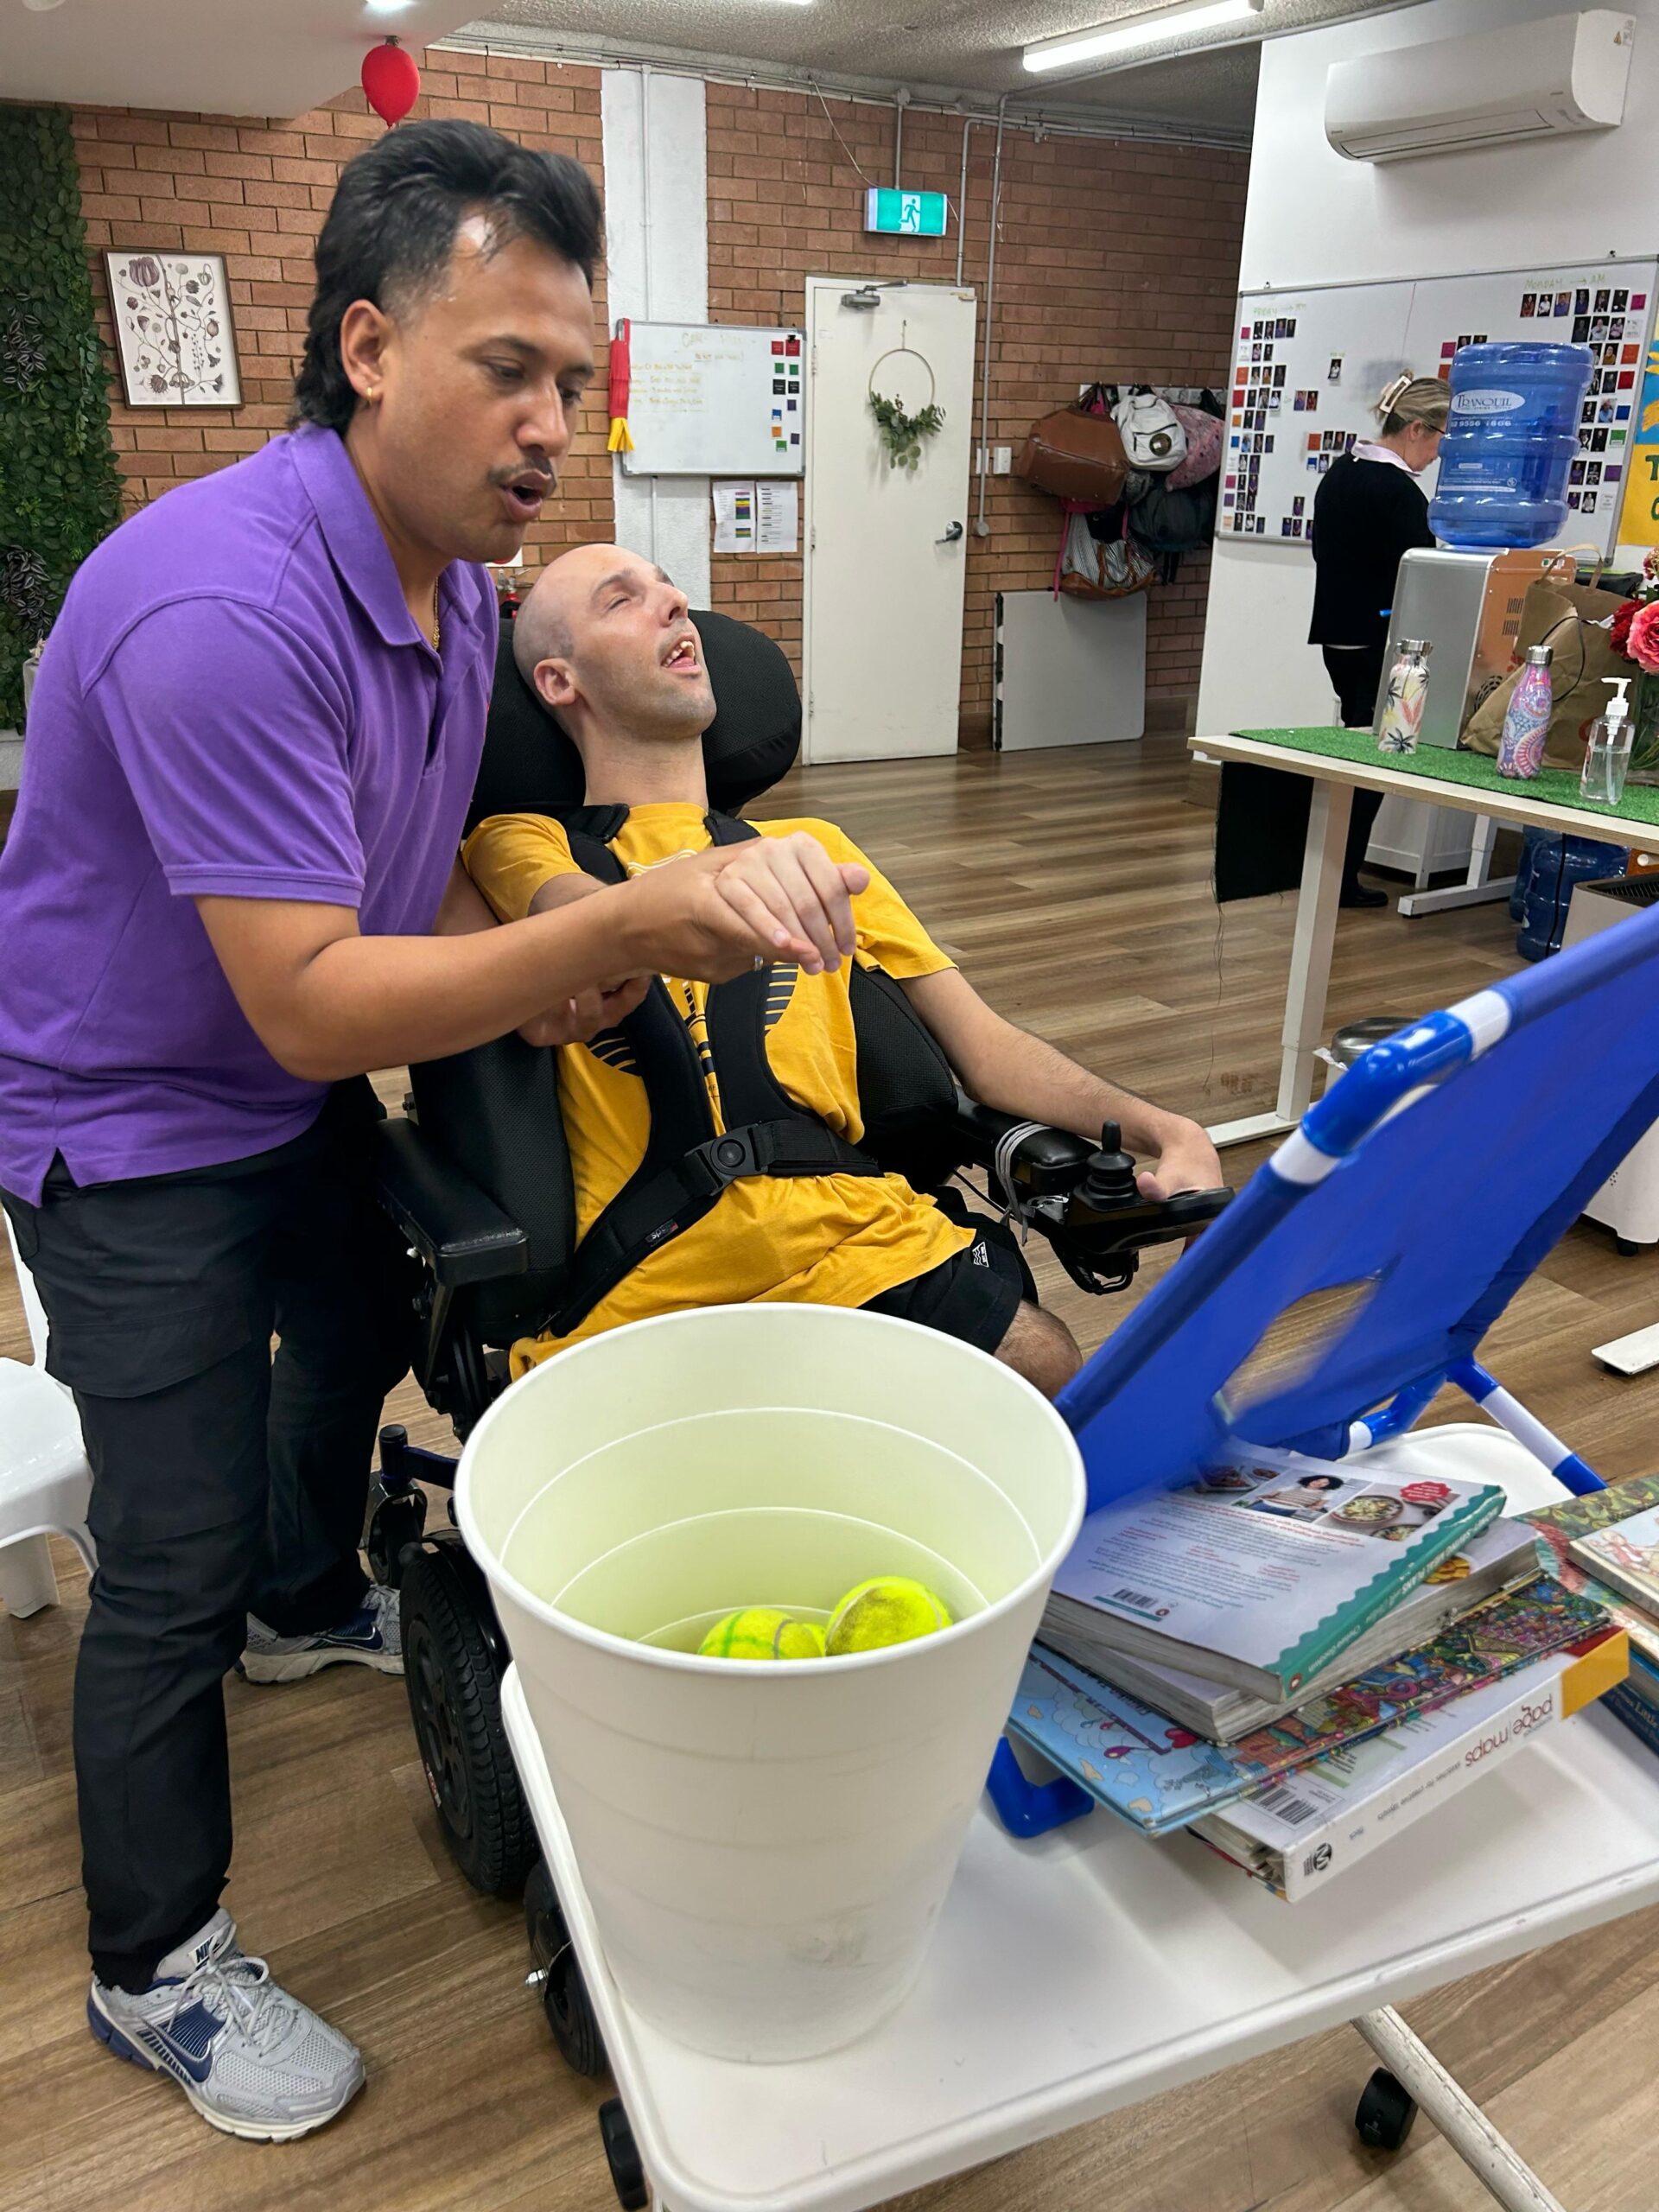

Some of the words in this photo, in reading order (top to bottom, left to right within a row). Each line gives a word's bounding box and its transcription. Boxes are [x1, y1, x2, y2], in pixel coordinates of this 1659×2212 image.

[1457, 394, 1512, 408] TRANQUIL
[1512, 1694, 1554, 1736] page
[1465, 1726, 1510, 1769] maps
